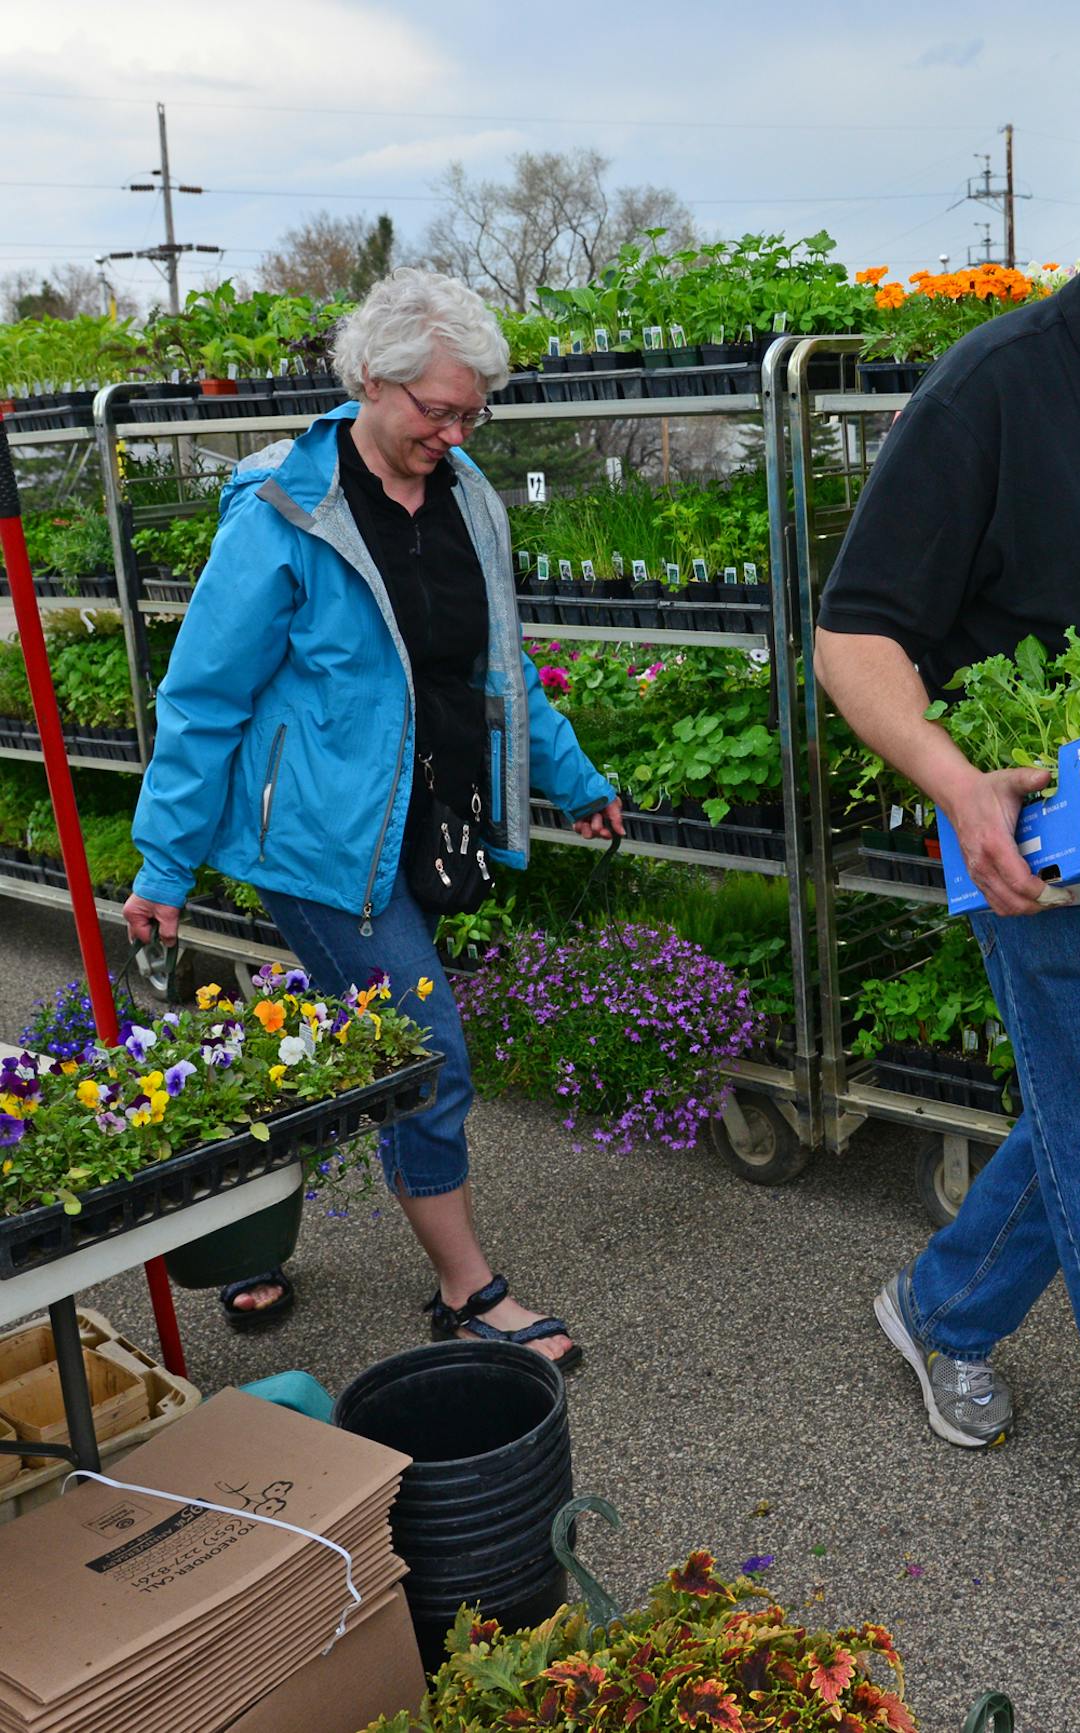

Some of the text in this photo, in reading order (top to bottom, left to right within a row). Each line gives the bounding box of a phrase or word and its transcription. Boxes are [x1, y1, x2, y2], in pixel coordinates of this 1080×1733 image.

[237, 1522, 258, 1537] TO
[131, 1518, 243, 1588] (651) 227-8261
[174, 1536, 238, 1576] REORDER
[139, 1574, 175, 1594] CALL
